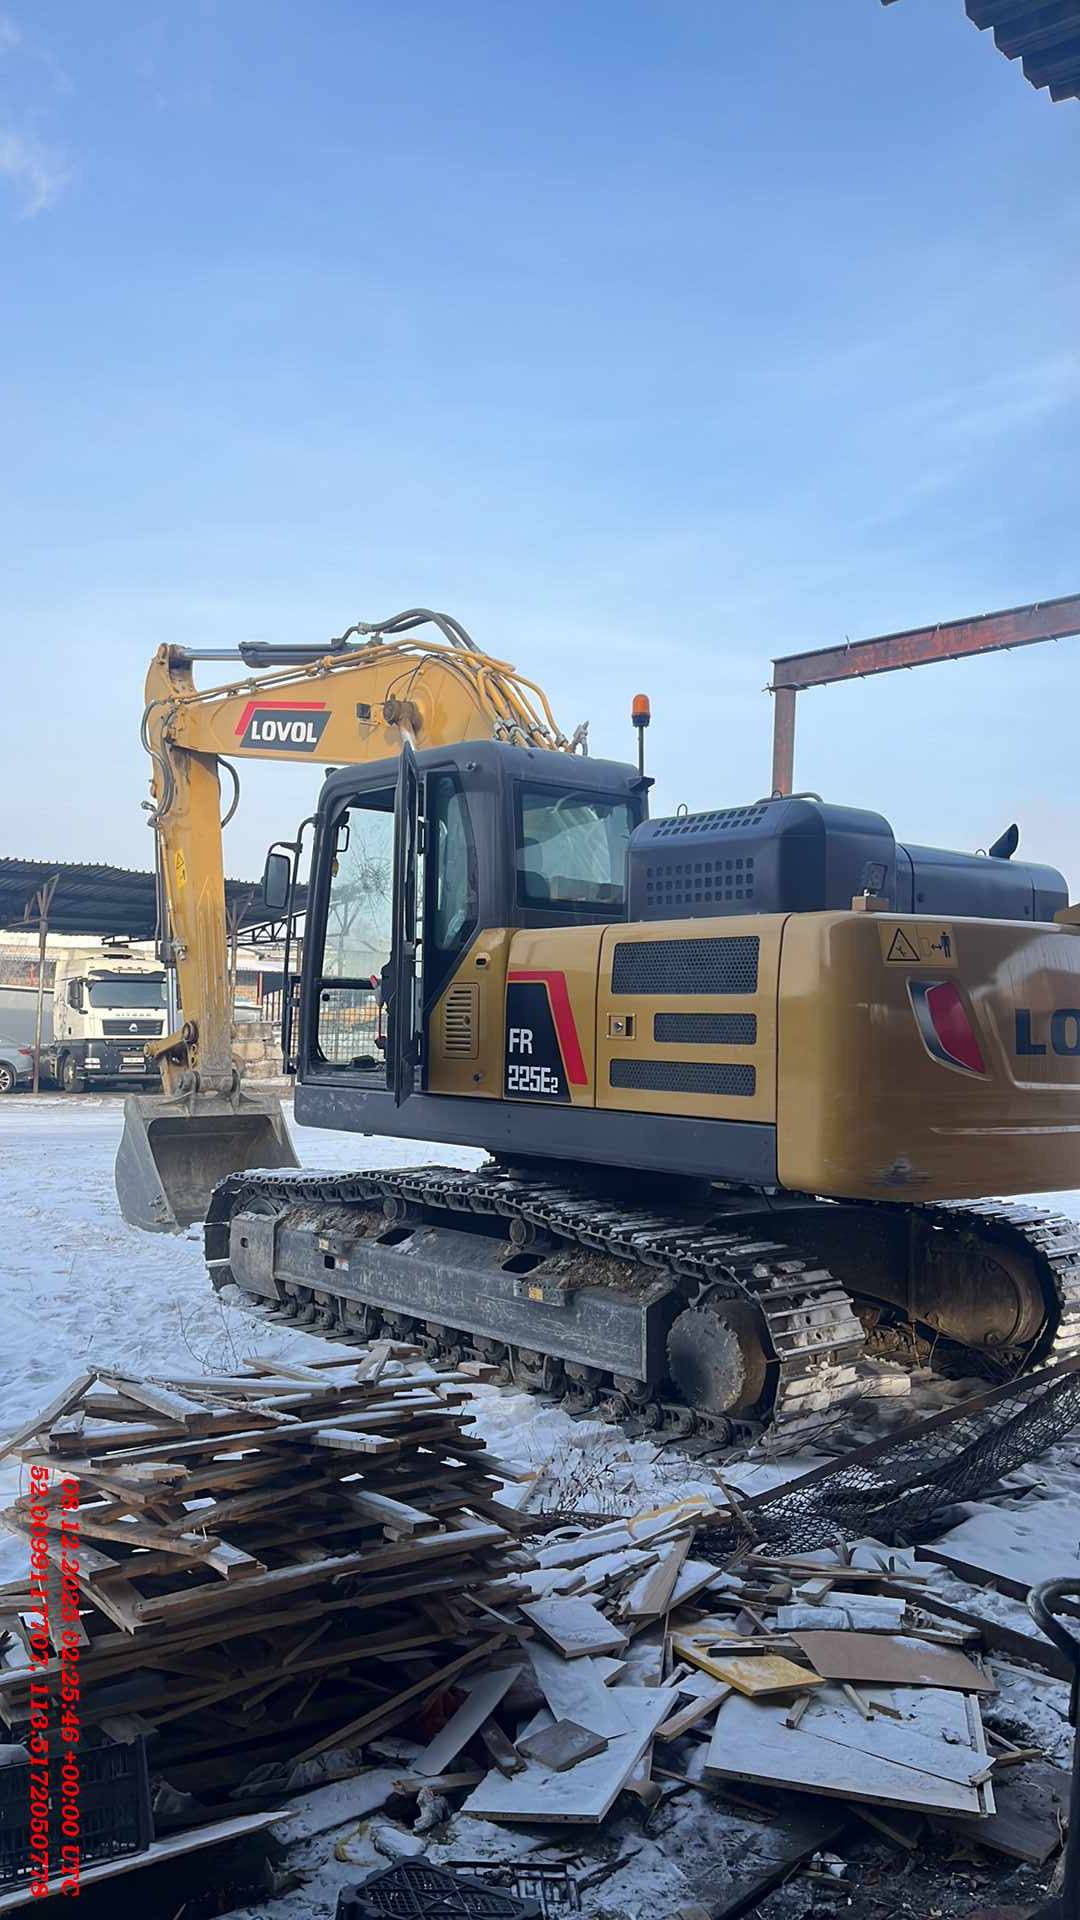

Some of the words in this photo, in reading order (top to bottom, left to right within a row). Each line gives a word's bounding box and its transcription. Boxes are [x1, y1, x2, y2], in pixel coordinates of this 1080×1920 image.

[251, 720, 318, 743] LOVOL
[508, 1027, 534, 1054] FR
[1015, 1007, 1080, 1056] LO
